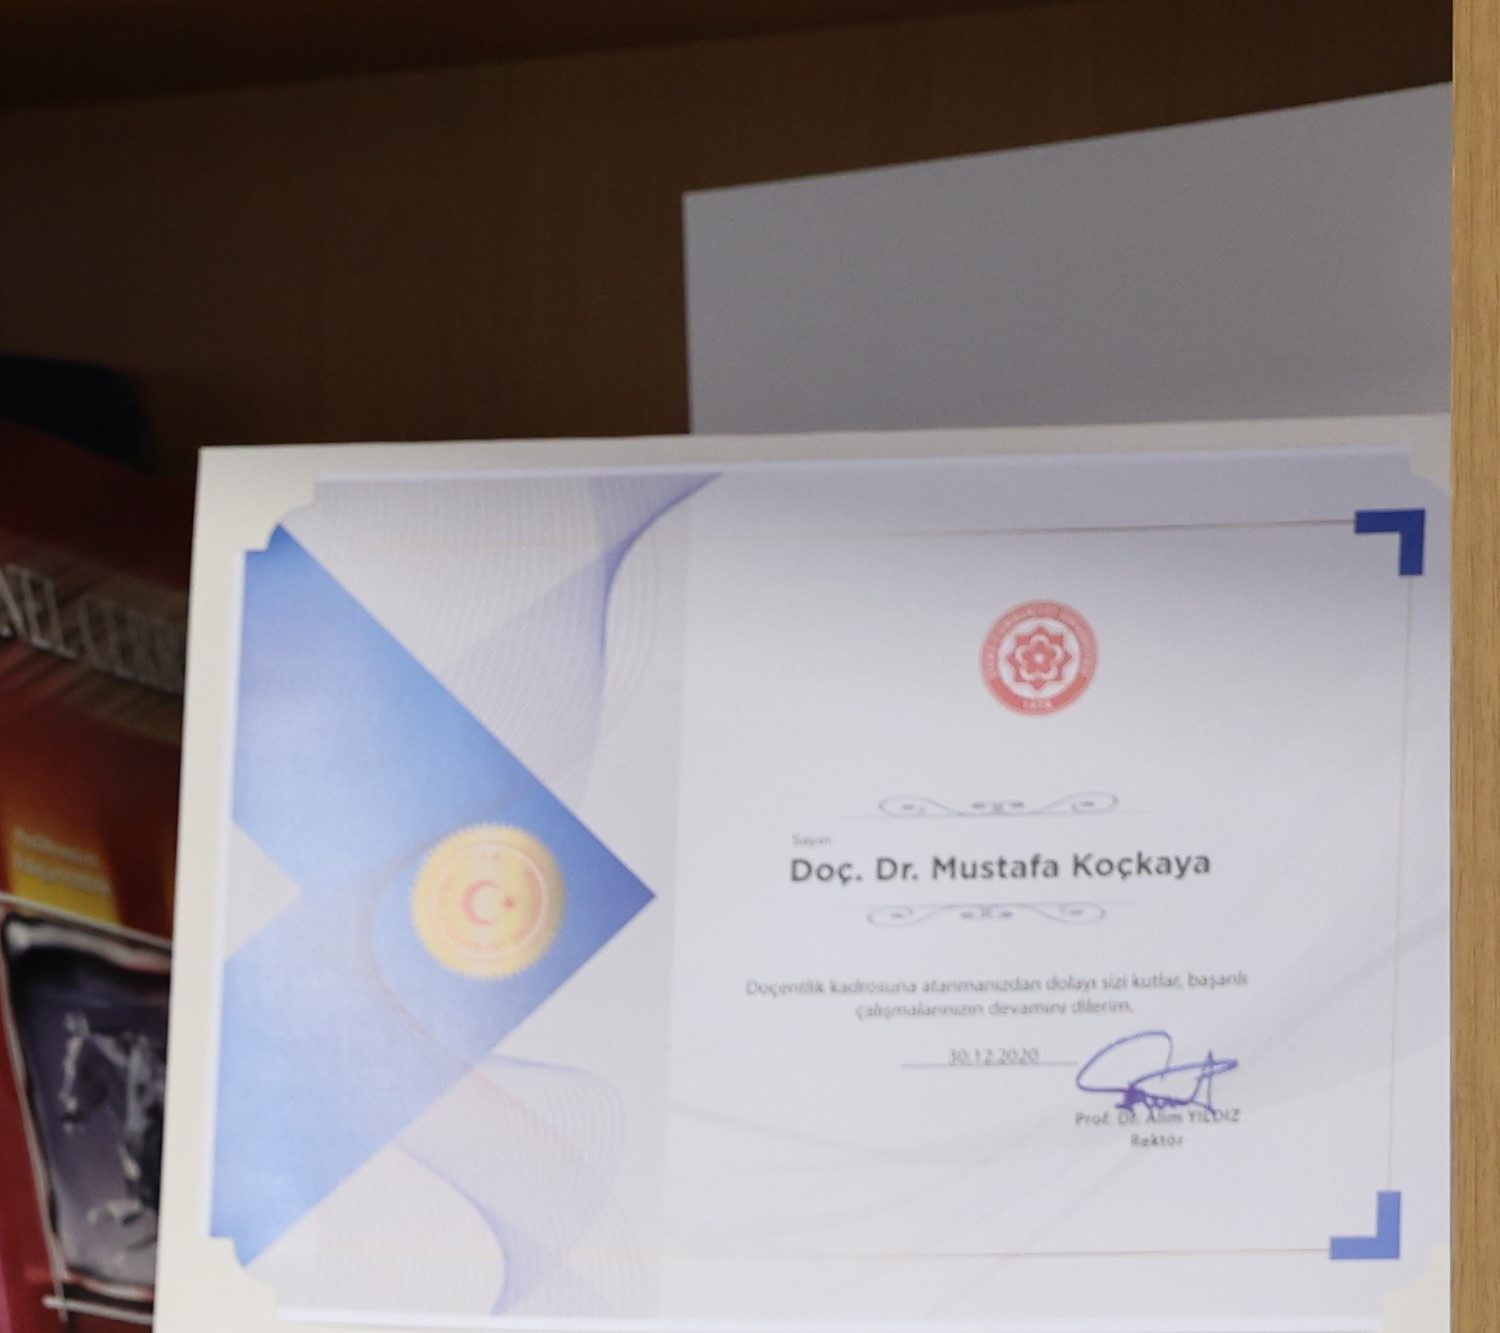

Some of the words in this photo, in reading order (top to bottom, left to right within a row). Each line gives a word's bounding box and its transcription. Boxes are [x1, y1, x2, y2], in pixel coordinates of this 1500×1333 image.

[790, 857, 863, 887] Doç.
[876, 857, 919, 882] Dr.
[931, 853, 1060, 882] Mustafa
[1071, 850, 1211, 881] Koçkaya
